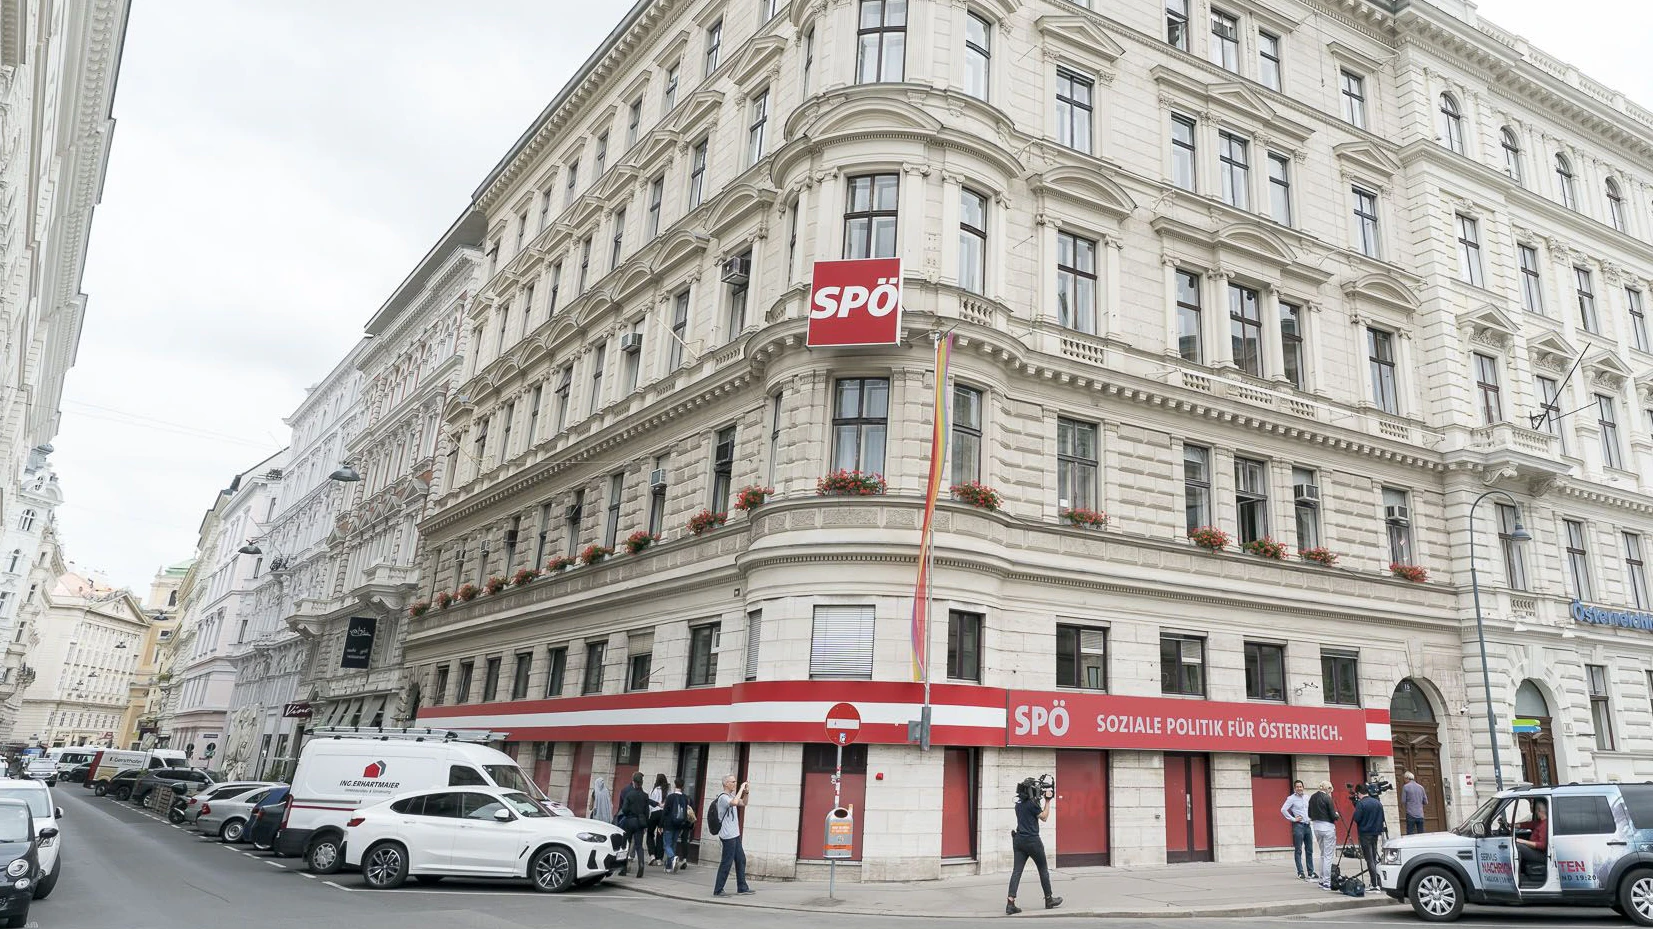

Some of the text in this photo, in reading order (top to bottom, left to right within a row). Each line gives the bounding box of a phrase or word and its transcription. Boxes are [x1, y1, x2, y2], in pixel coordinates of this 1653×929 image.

[810, 278, 899, 319] SPÖ
[1014, 699, 1343, 741] SPÖ SOZIALE POLITIK FÜR ÖSTERREICH.
